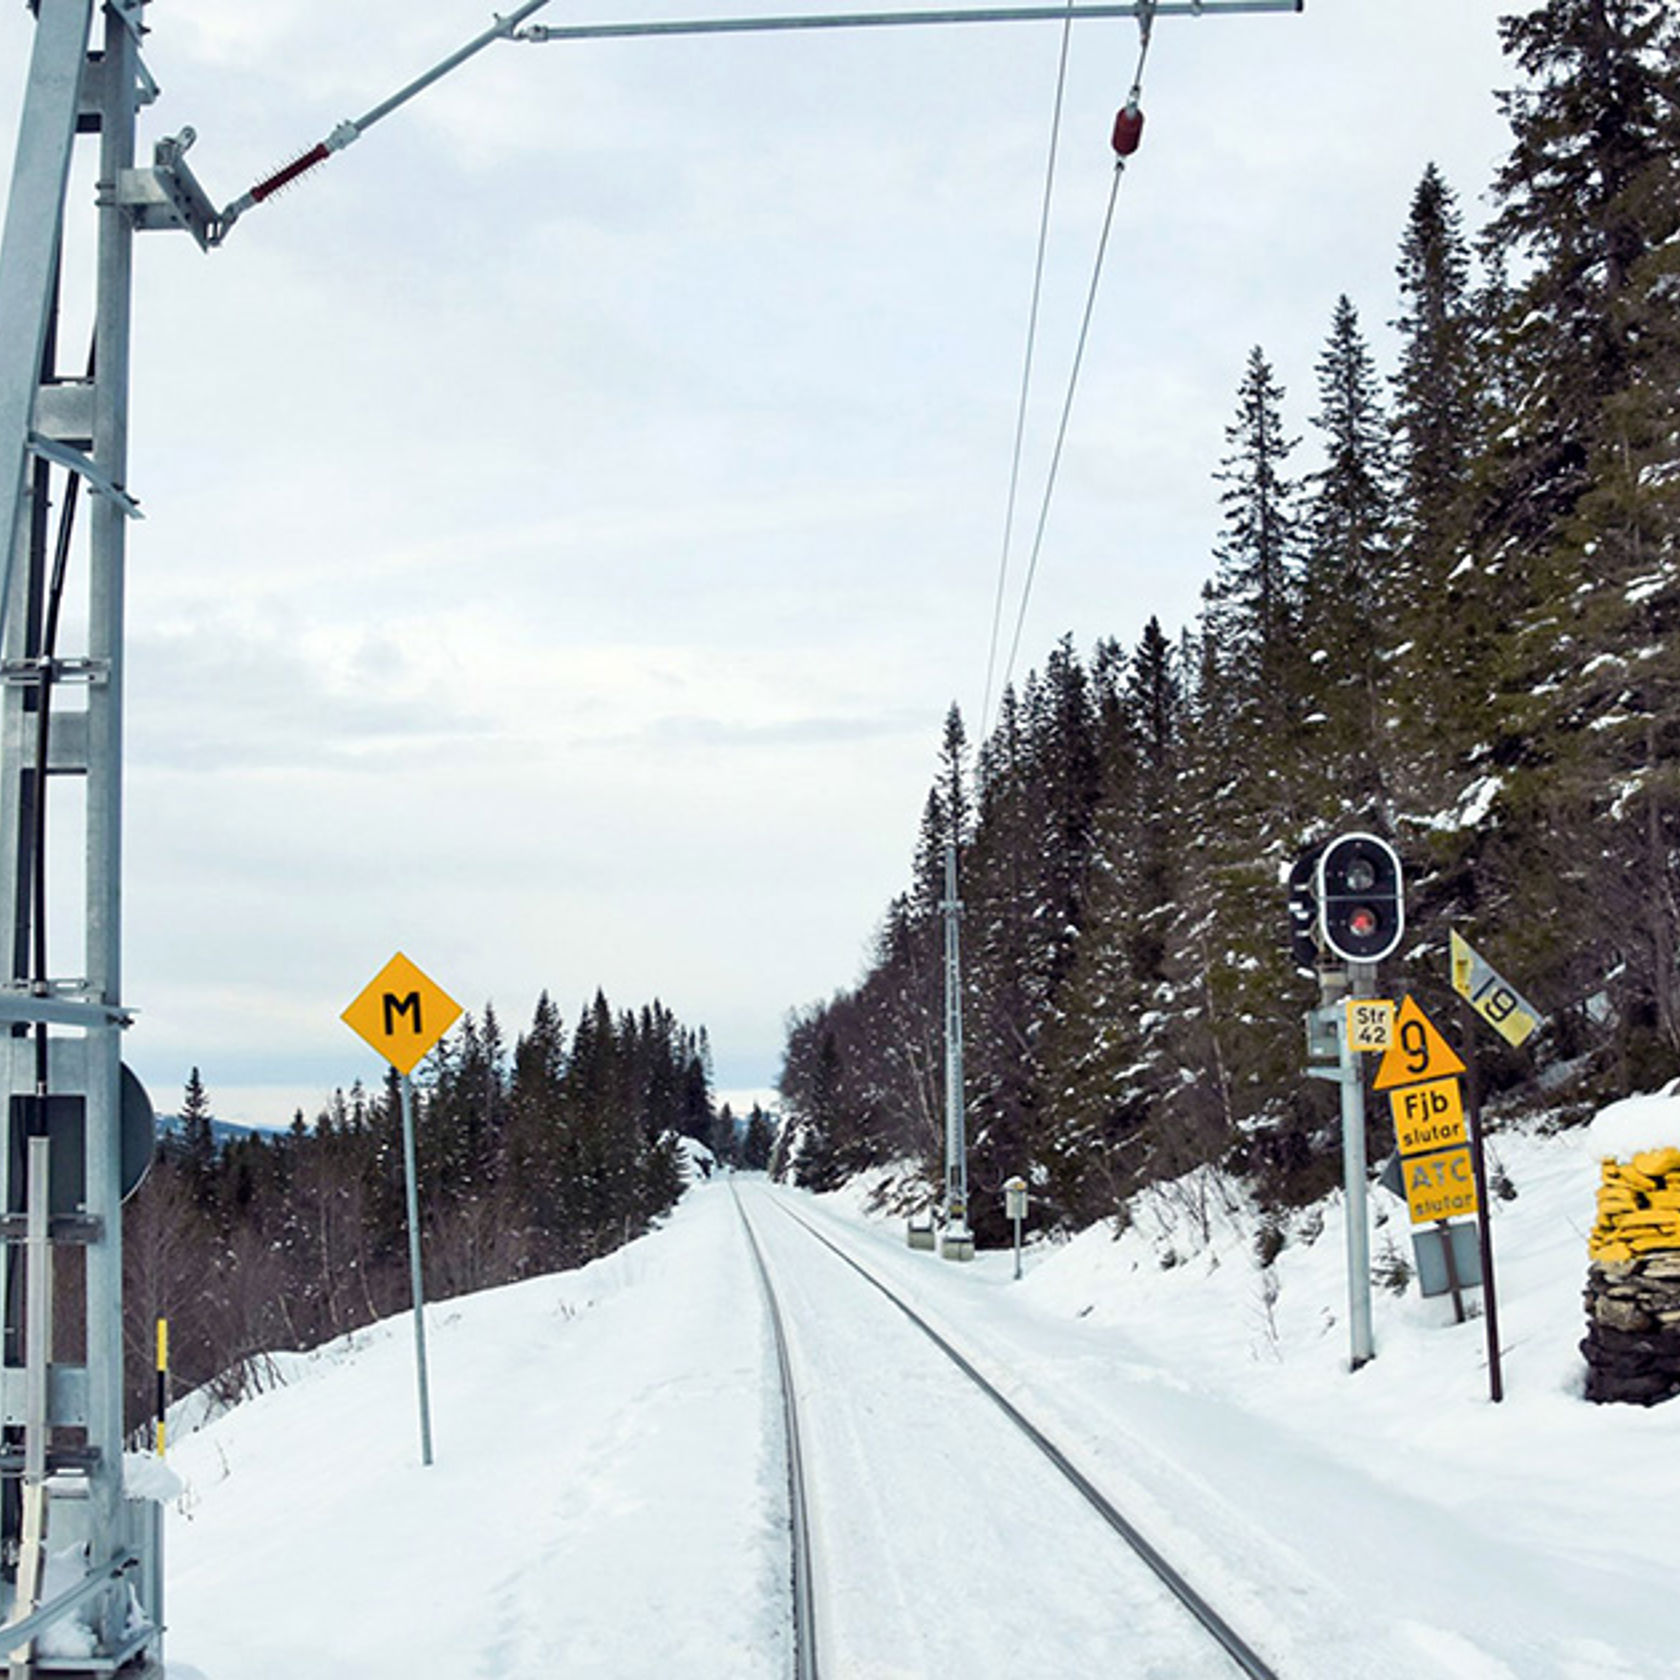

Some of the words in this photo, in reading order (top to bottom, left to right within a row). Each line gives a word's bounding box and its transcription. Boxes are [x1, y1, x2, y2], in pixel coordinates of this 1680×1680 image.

[383, 991, 422, 1036] M
[1357, 1007, 1386, 1024] Str
[1359, 1026, 1387, 1044] 42
[1401, 1020, 1430, 1074] 9
[1404, 1090, 1448, 1122] Fjb
[1403, 1123, 1460, 1147] slutar
[1411, 1157, 1469, 1190] ATC
[1415, 1194, 1473, 1216] slutar
